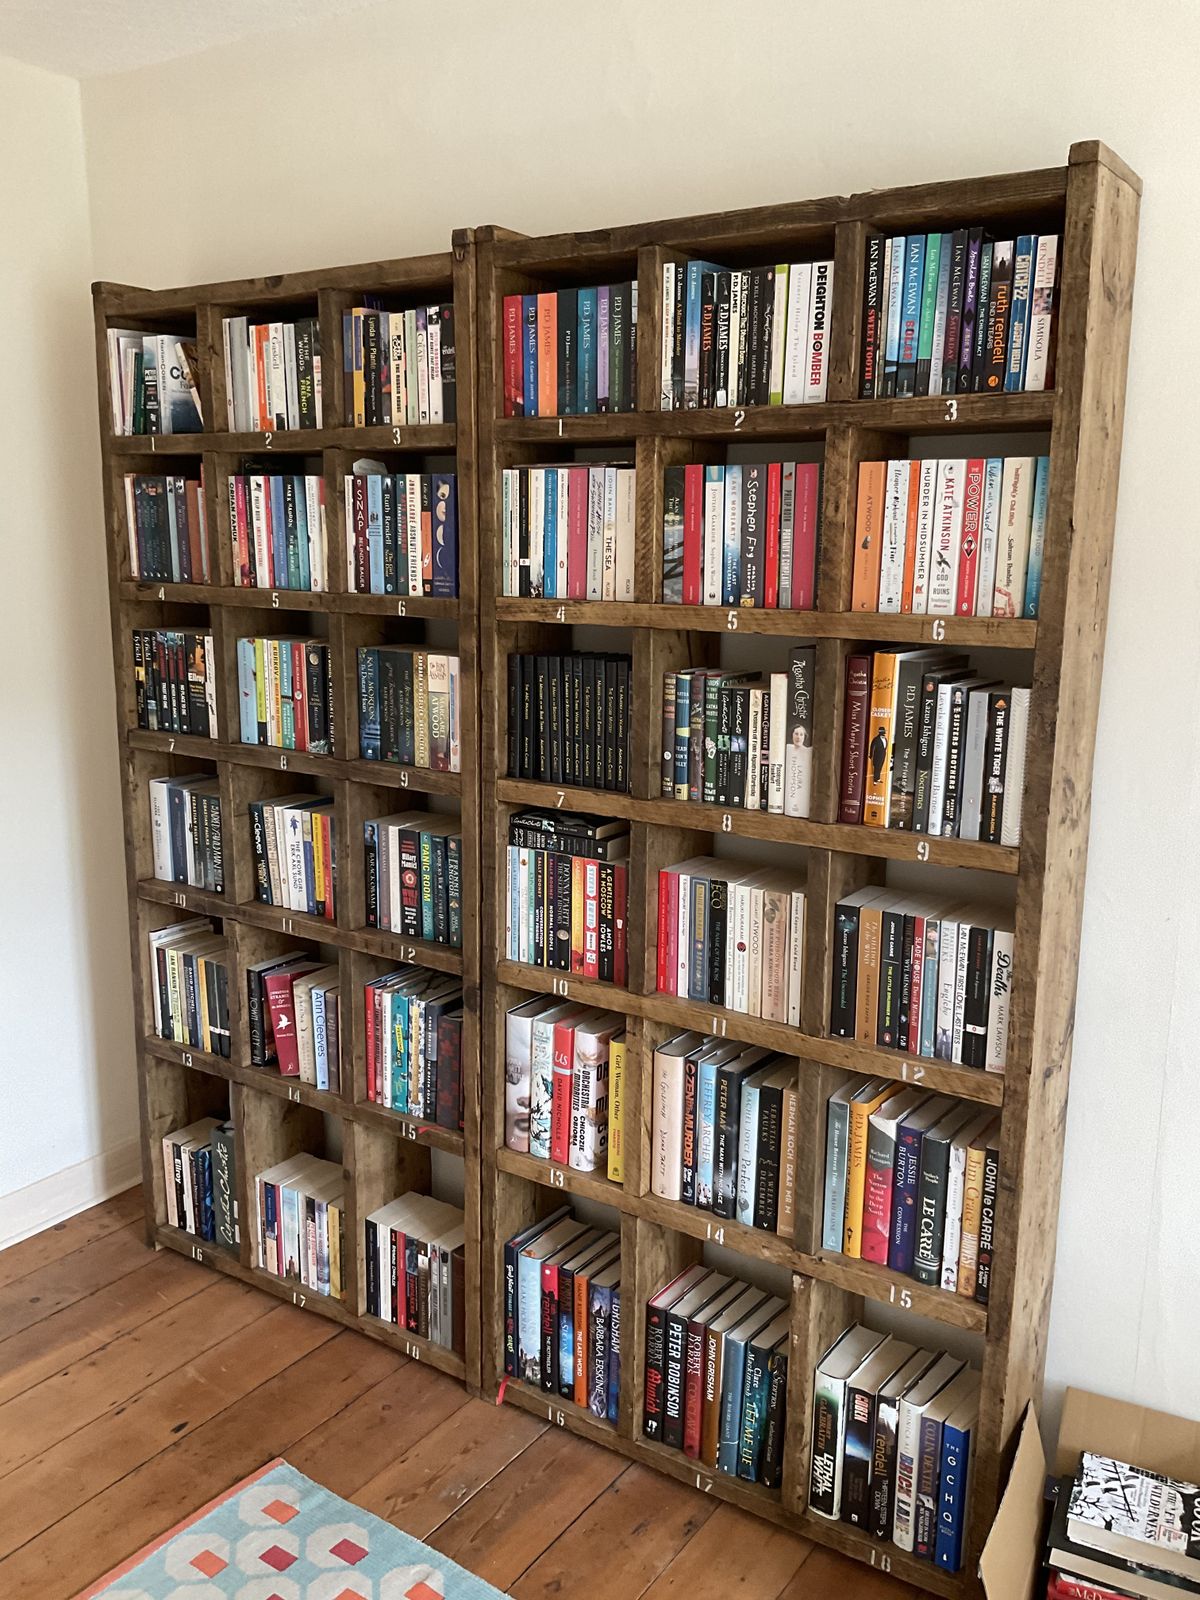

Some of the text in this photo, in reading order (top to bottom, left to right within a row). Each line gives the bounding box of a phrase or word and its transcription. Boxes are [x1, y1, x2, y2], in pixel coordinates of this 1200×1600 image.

[870, 240, 878, 259] IAN
[868, 261, 877, 306] McEWAN
[1014, 255, 1030, 300] CATCH-22
[810, 265, 827, 385] DEIGHTON BOMBER
[992, 286, 1008, 363] ruth rendell
[508, 325, 516, 354] JAMES
[1010, 322, 1023, 372] JOSEPH HELLER
[1034, 318, 1044, 361] SIMISOLA
[865, 345, 873, 380] TOOTH
[735, 411, 744, 431] 2
[945, 400, 957, 420] 3
[266, 433, 272, 448] 2
[393, 428, 400, 444] 3
[940, 479, 954, 551] KATE ATKINSON
[966, 474, 979, 532] POWER
[746, 480, 758, 558] Stephen Fry
[918, 468, 930, 579] MURDER IN MIDSUMMER
[159, 587, 164, 600] 4
[273, 593, 278, 607] 5
[399, 601, 405, 616] 6
[557, 606, 564, 622] 4
[728, 611, 737, 629] 5
[933, 620, 944, 640] 6
[793, 660, 809, 718] Agatha Christie
[920, 699, 933, 756] Kazuo Ishiguro
[169, 739, 174, 751] 7
[847, 701, 861, 794] Miss Marple Short Stories
[949, 714, 960, 789] SISTERS BROTHERS
[992, 711, 1005, 775] THE WHITE TIGER
[281, 756, 286, 769] 8
[401, 772, 408, 787] 9
[917, 770, 927, 809] Nocturnes
[557, 792, 565, 807] 7
[723, 815, 731, 831] 8
[422, 844, 430, 871] PANIC
[918, 842, 929, 861] 9
[601, 870, 606, 878] IN
[176, 893, 185, 907] 10
[711, 884, 721, 908] ECO
[283, 918, 291, 932] 11
[401, 946, 415, 963] 12
[913, 960, 921, 984] HOUSE
[994, 951, 1010, 998] Deaths
[554, 979, 568, 995] 10
[314, 992, 325, 1057] Ann Cleeves
[713, 1018, 726, 1036] 11
[994, 1005, 1004, 1058] MARK LAWSON
[183, 1053, 192, 1066] 13
[902, 1063, 924, 1085] 12
[289, 1087, 299, 1102] 14
[720, 1079, 728, 1108] PETER
[703, 1078, 713, 1164] JEFFREY ARCHER
[788, 1094, 796, 1132] HERMAN
[403, 1123, 415, 1139] 15
[787, 1135, 795, 1159] KOCH
[551, 1169, 563, 1186] 13
[740, 1158, 751, 1194] Perfect
[897, 1146, 906, 1187] BURTON
[907, 1153, 917, 1184] JESSIE
[785, 1190, 792, 1203] MR
[965, 1156, 982, 1226] Jim Crace
[980, 1159, 996, 1250] JOHN le CARRÉ
[707, 1224, 724, 1244] 14
[919, 1197, 936, 1258] LE CARRÉ
[193, 1246, 202, 1260] 16
[294, 1293, 305, 1307] 17
[890, 1286, 911, 1308] 15
[407, 1342, 419, 1359] 18
[596, 1317, 604, 1394] BARBARA ERSKINE
[667, 1322, 682, 1418] PETER ROBINSON
[707, 1361, 715, 1401] GRISHAM
[647, 1368, 662, 1413] Munich
[549, 1407, 564, 1425] 16
[742, 1402, 756, 1466] LET ME LIE
[922, 1422, 936, 1493] COLIN DEXTER
[697, 1475, 712, 1491] 17
[813, 1454, 824, 1496] WHITE
[823, 1452, 834, 1493] LETHAL
[896, 1453, 913, 1534] BRICK LANE
[871, 1550, 890, 1572] 18
